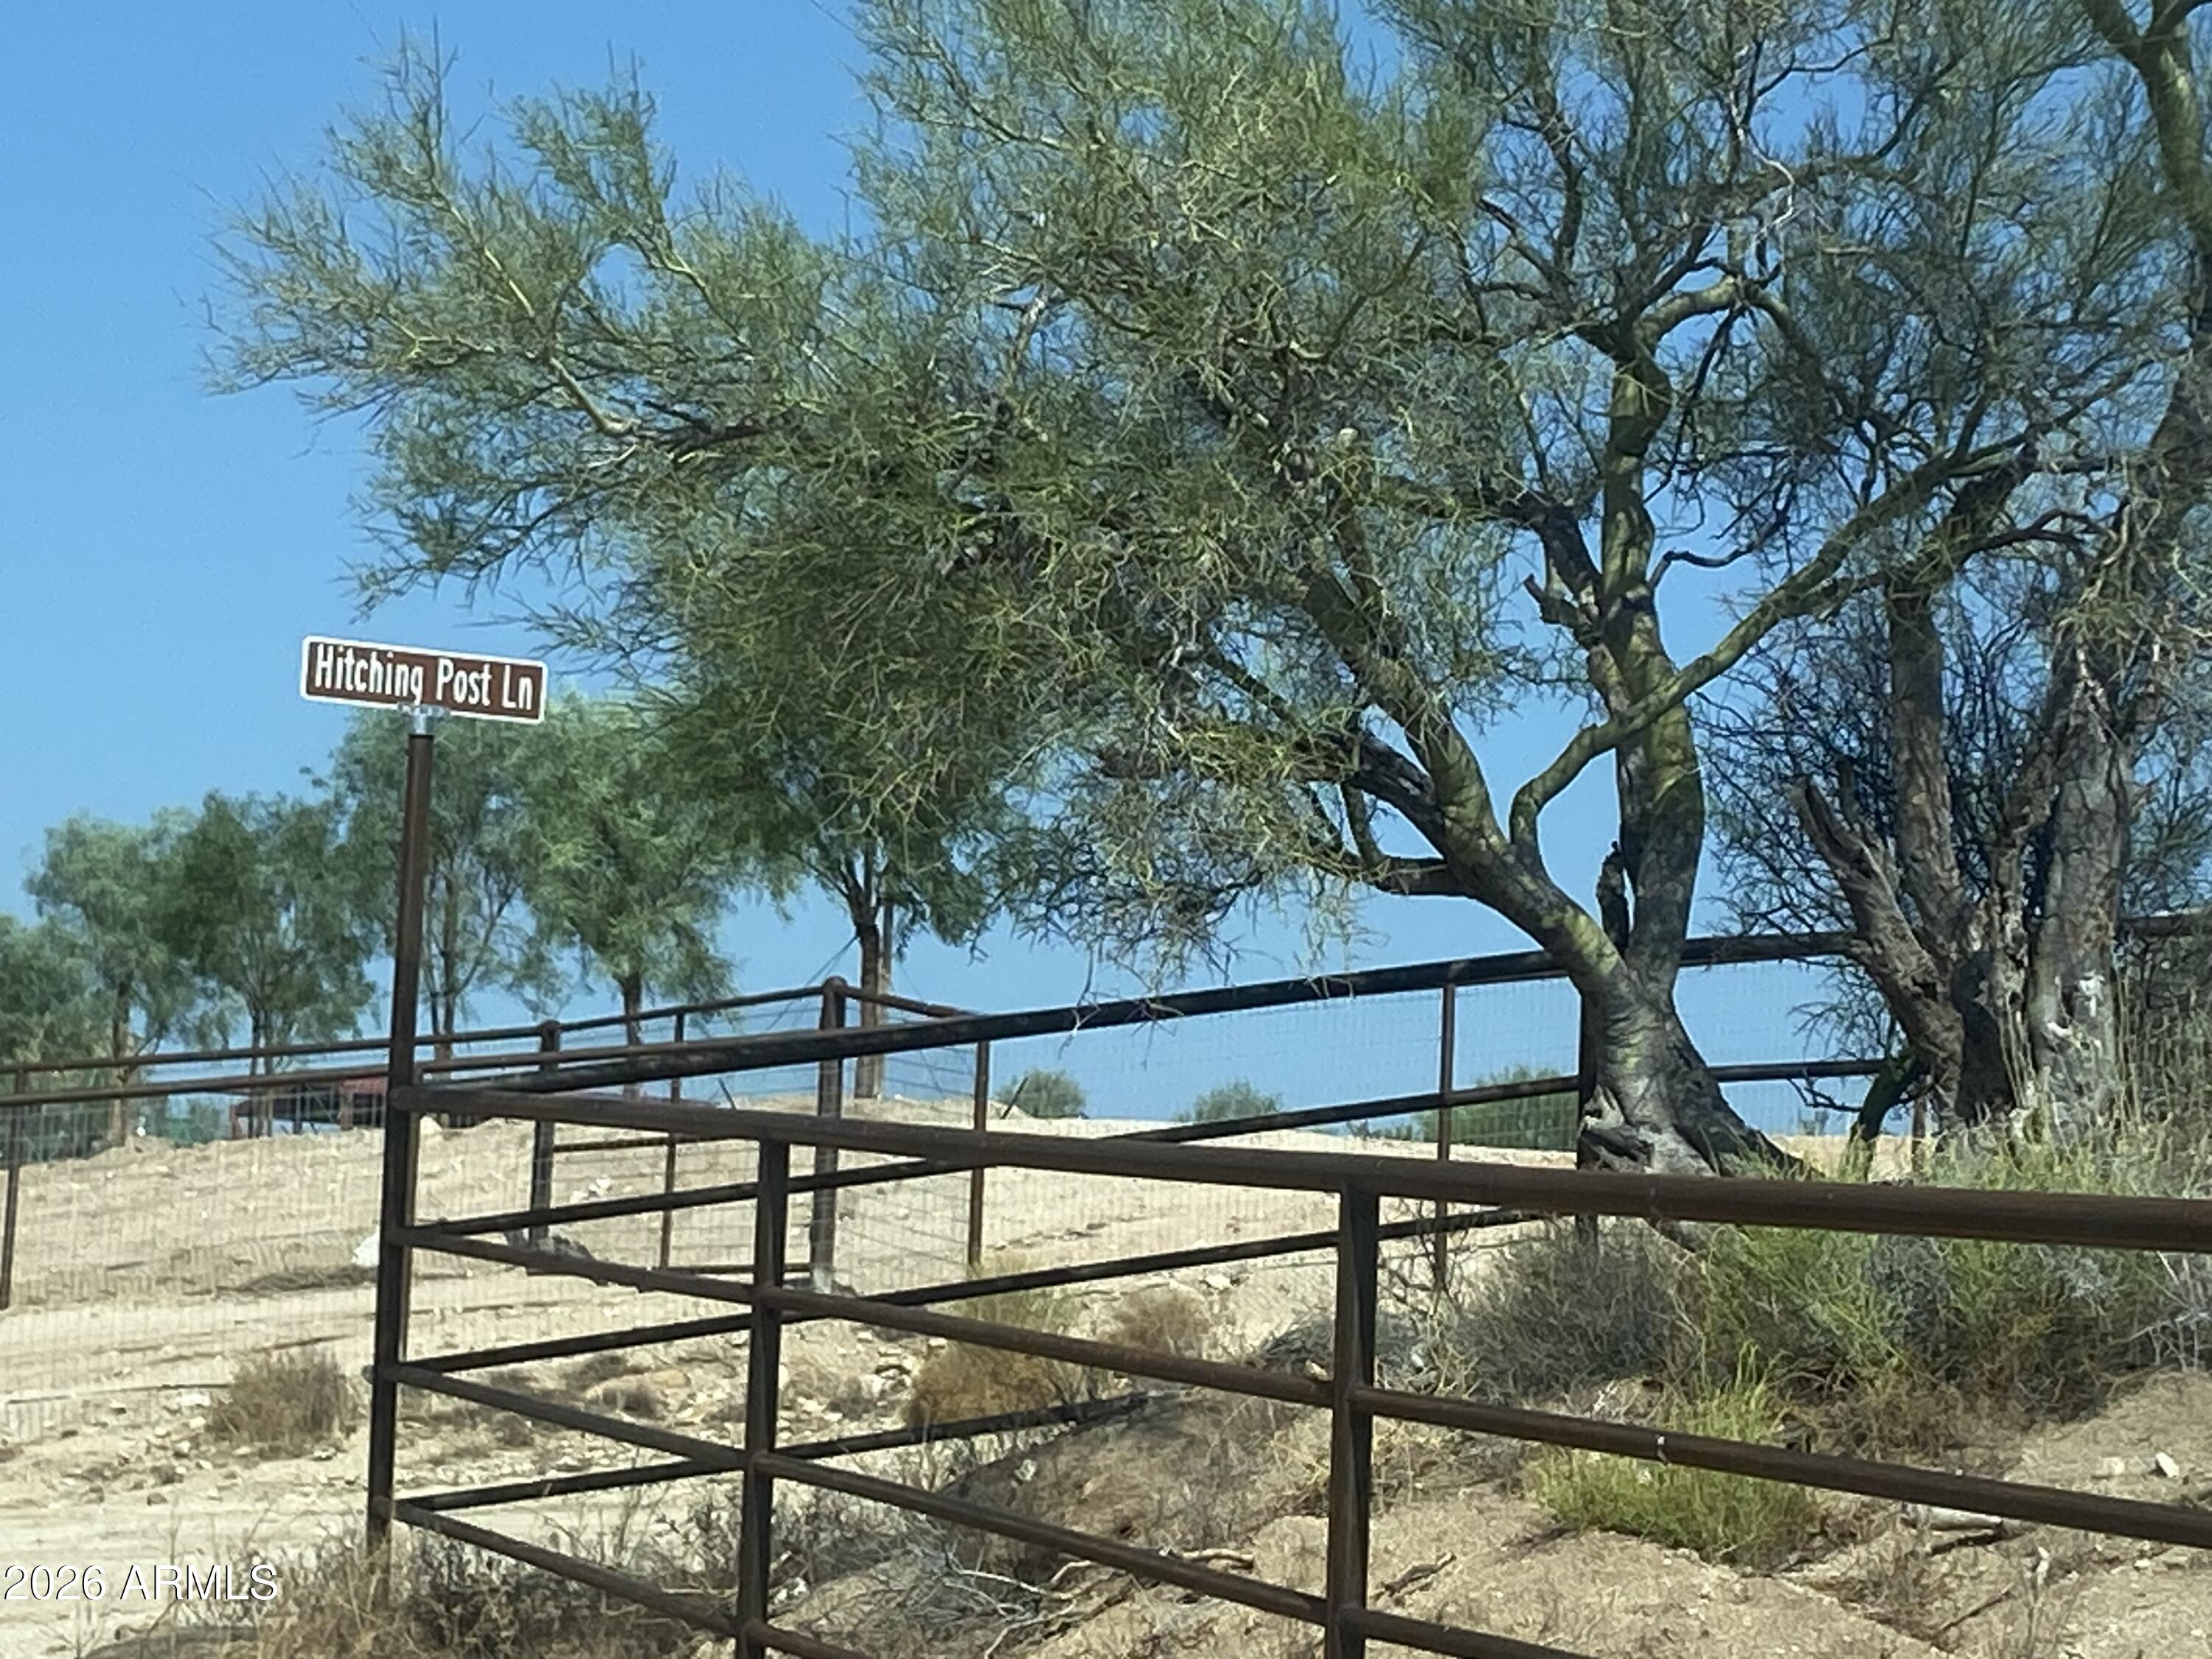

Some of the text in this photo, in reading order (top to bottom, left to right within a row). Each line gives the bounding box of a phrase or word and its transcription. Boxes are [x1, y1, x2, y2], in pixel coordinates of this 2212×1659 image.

[315, 643, 533, 710] Hitching Post Ln
